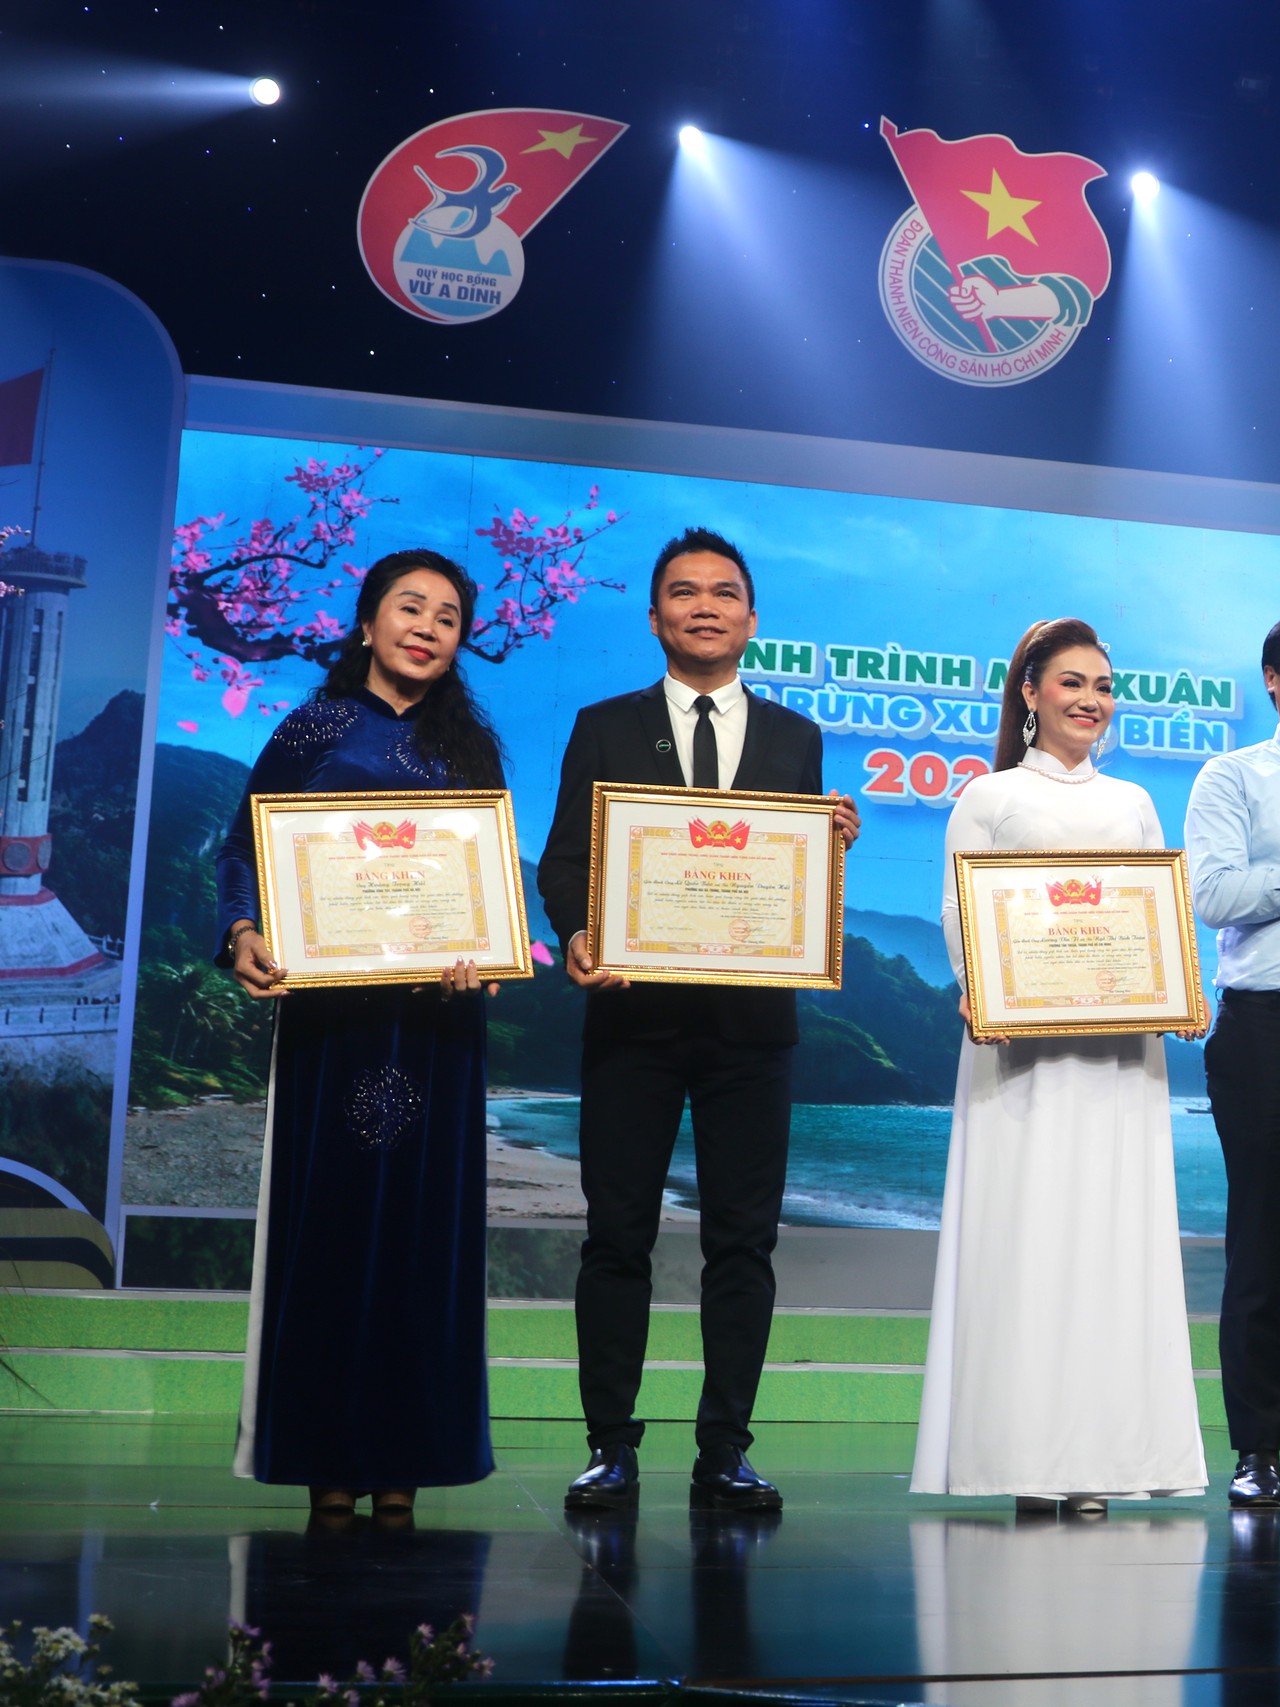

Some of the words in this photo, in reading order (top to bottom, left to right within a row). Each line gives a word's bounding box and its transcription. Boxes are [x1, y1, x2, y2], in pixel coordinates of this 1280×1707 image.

[894, 219, 924, 258] ĐOÀN
[438, 283, 451, 298] A
[441, 271, 463, 283] HỌC
[888, 259, 906, 305] THANH
[895, 302, 923, 340] NIÊN
[918, 337, 957, 369] CỘNG
[1035, 328, 1067, 361] MINH
[958, 359, 988, 377] SẢN
[991, 358, 1012, 377] HỒ
[1013, 350, 1039, 372] CHÍ
[737, 641, 812, 675] NH
[829, 646, 974, 688] TRÌNH
[1111, 671, 1231, 709] XUÂN
[1125, 713, 1223, 751] BIỂN
[865, 750, 990, 799] 202
[719, 871, 752, 881] KHEN
[1080, 926, 1111, 935] KHEN
